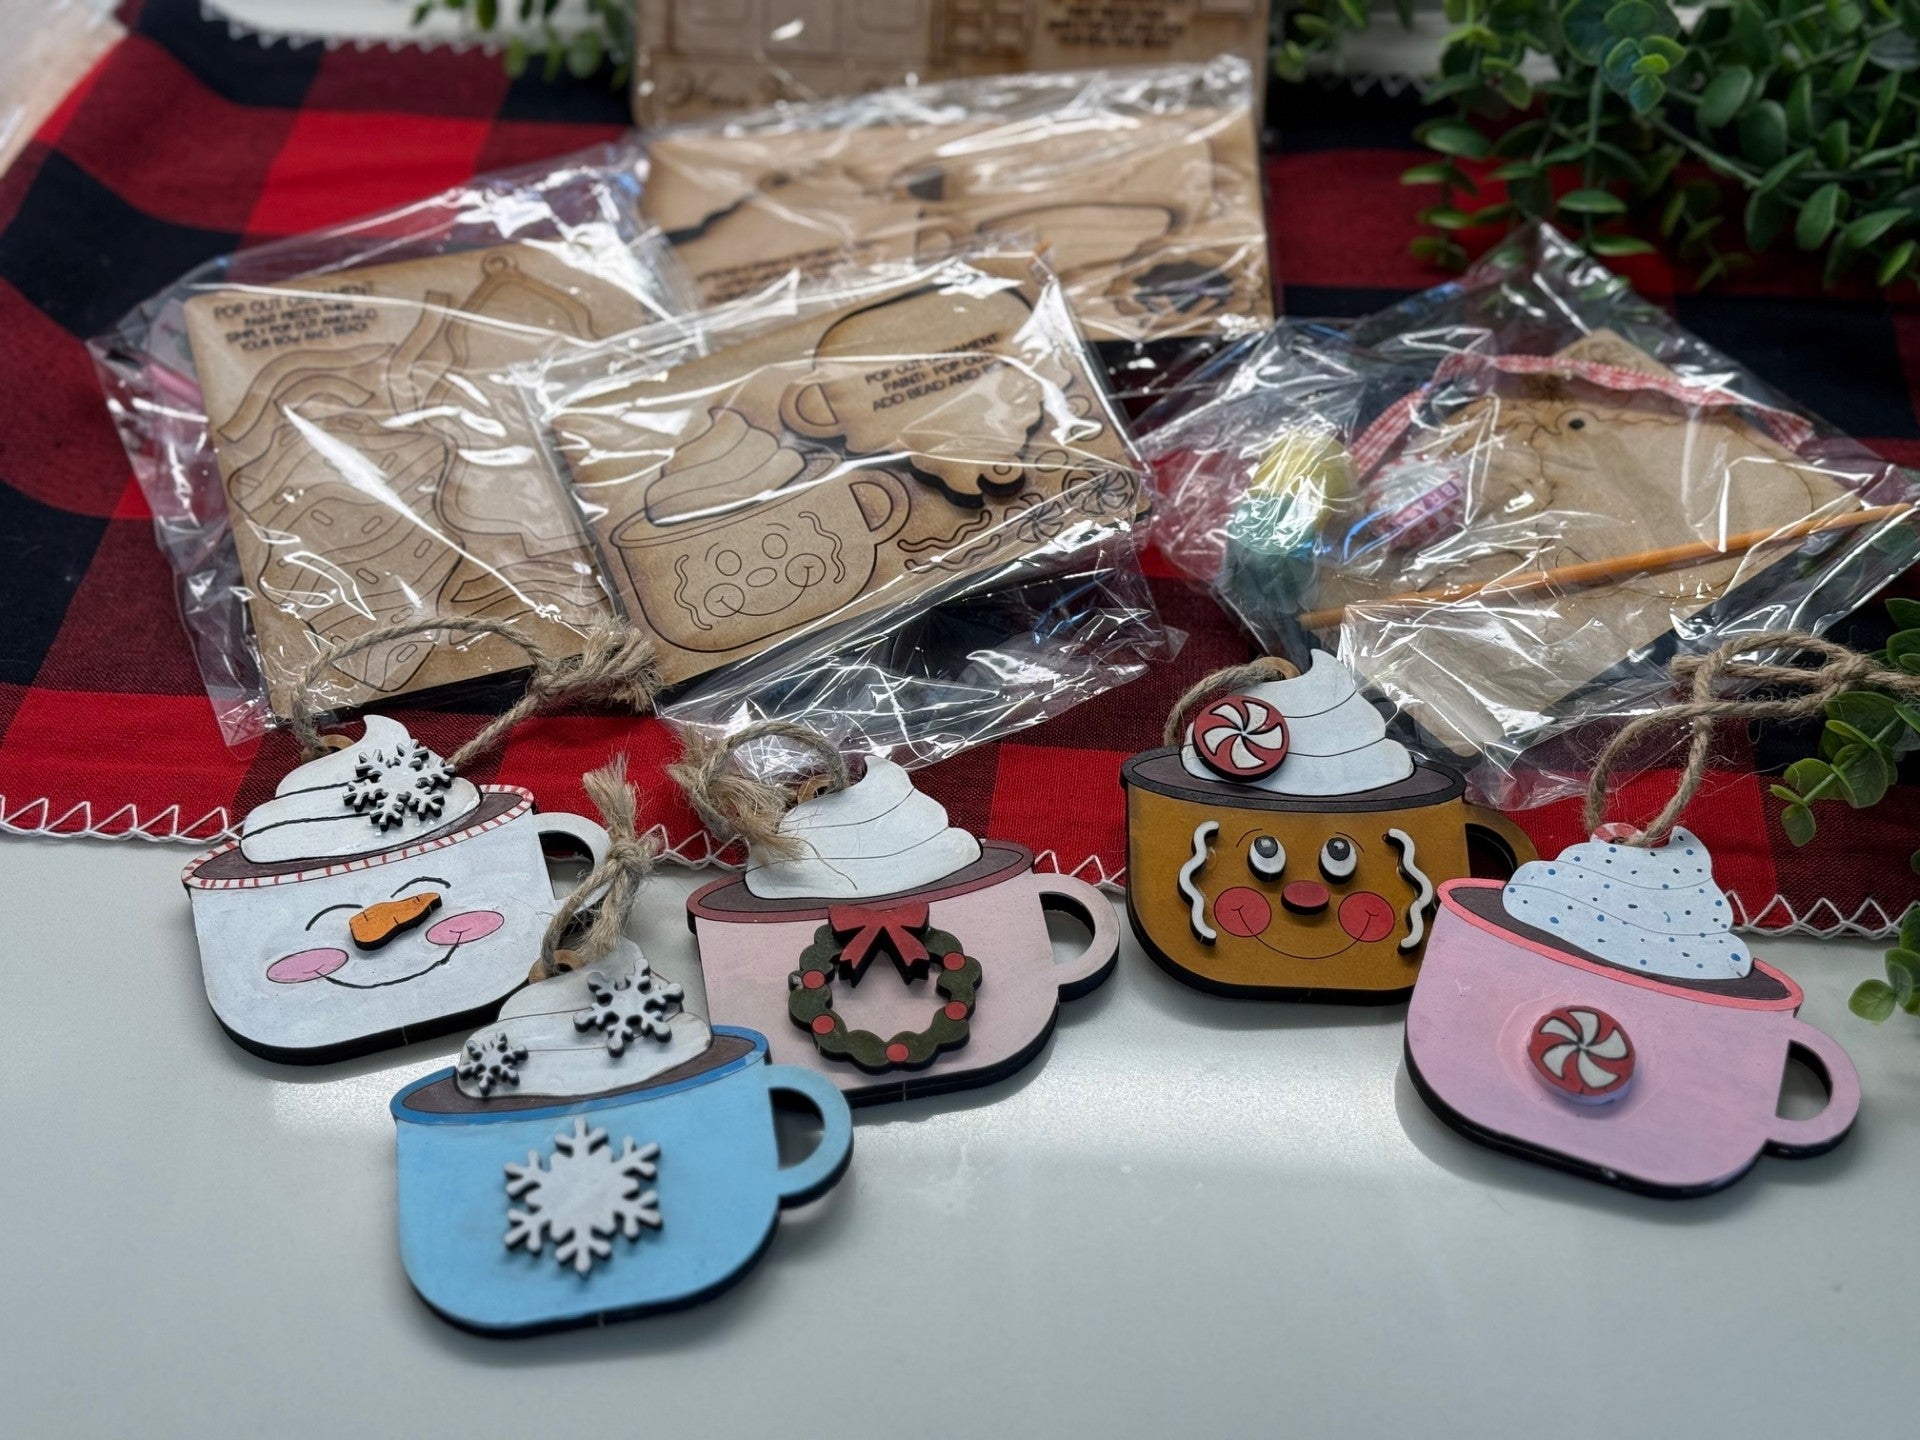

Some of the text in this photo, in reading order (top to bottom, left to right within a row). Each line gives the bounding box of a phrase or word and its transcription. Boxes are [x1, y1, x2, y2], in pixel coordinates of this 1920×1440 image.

[213, 303, 245, 320] POP
[933, 361, 960, 376] POP
[864, 369, 892, 386] POP
[873, 367, 980, 412] ADD BEAD AND
